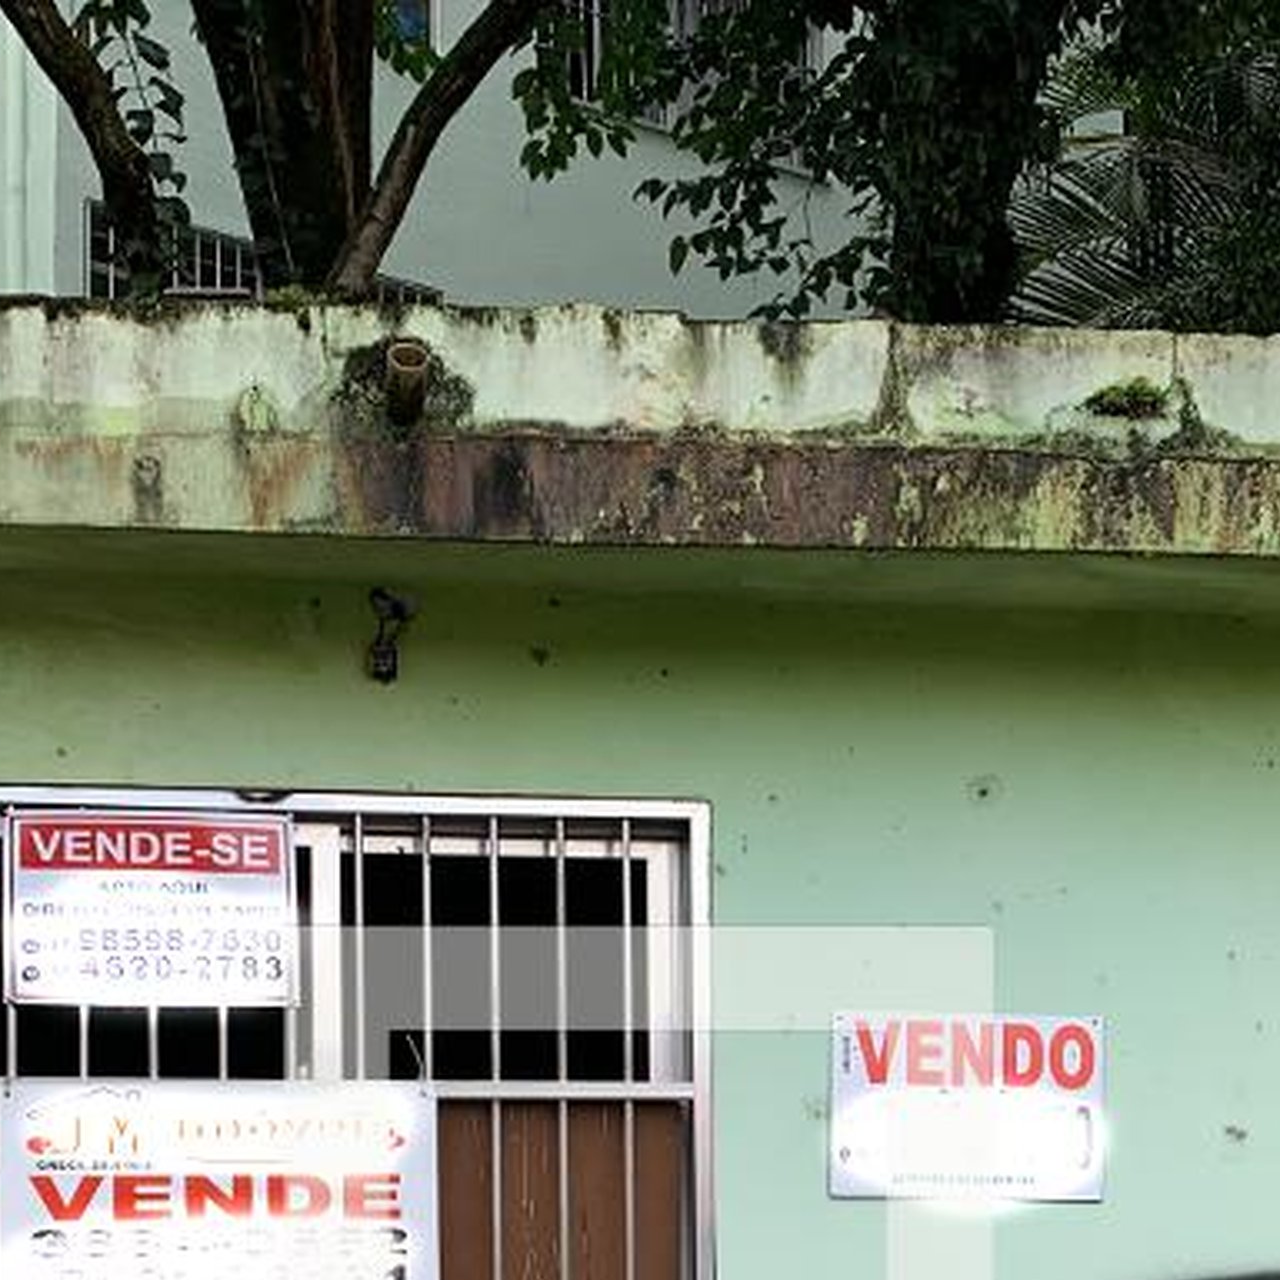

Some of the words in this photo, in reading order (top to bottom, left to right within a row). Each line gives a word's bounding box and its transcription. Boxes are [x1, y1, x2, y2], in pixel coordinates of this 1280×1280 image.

[31, 831, 271, 868] VENDE-SE
[854, 1018, 1096, 1091] VENDO
[29, 1174, 402, 1221] VENDE
